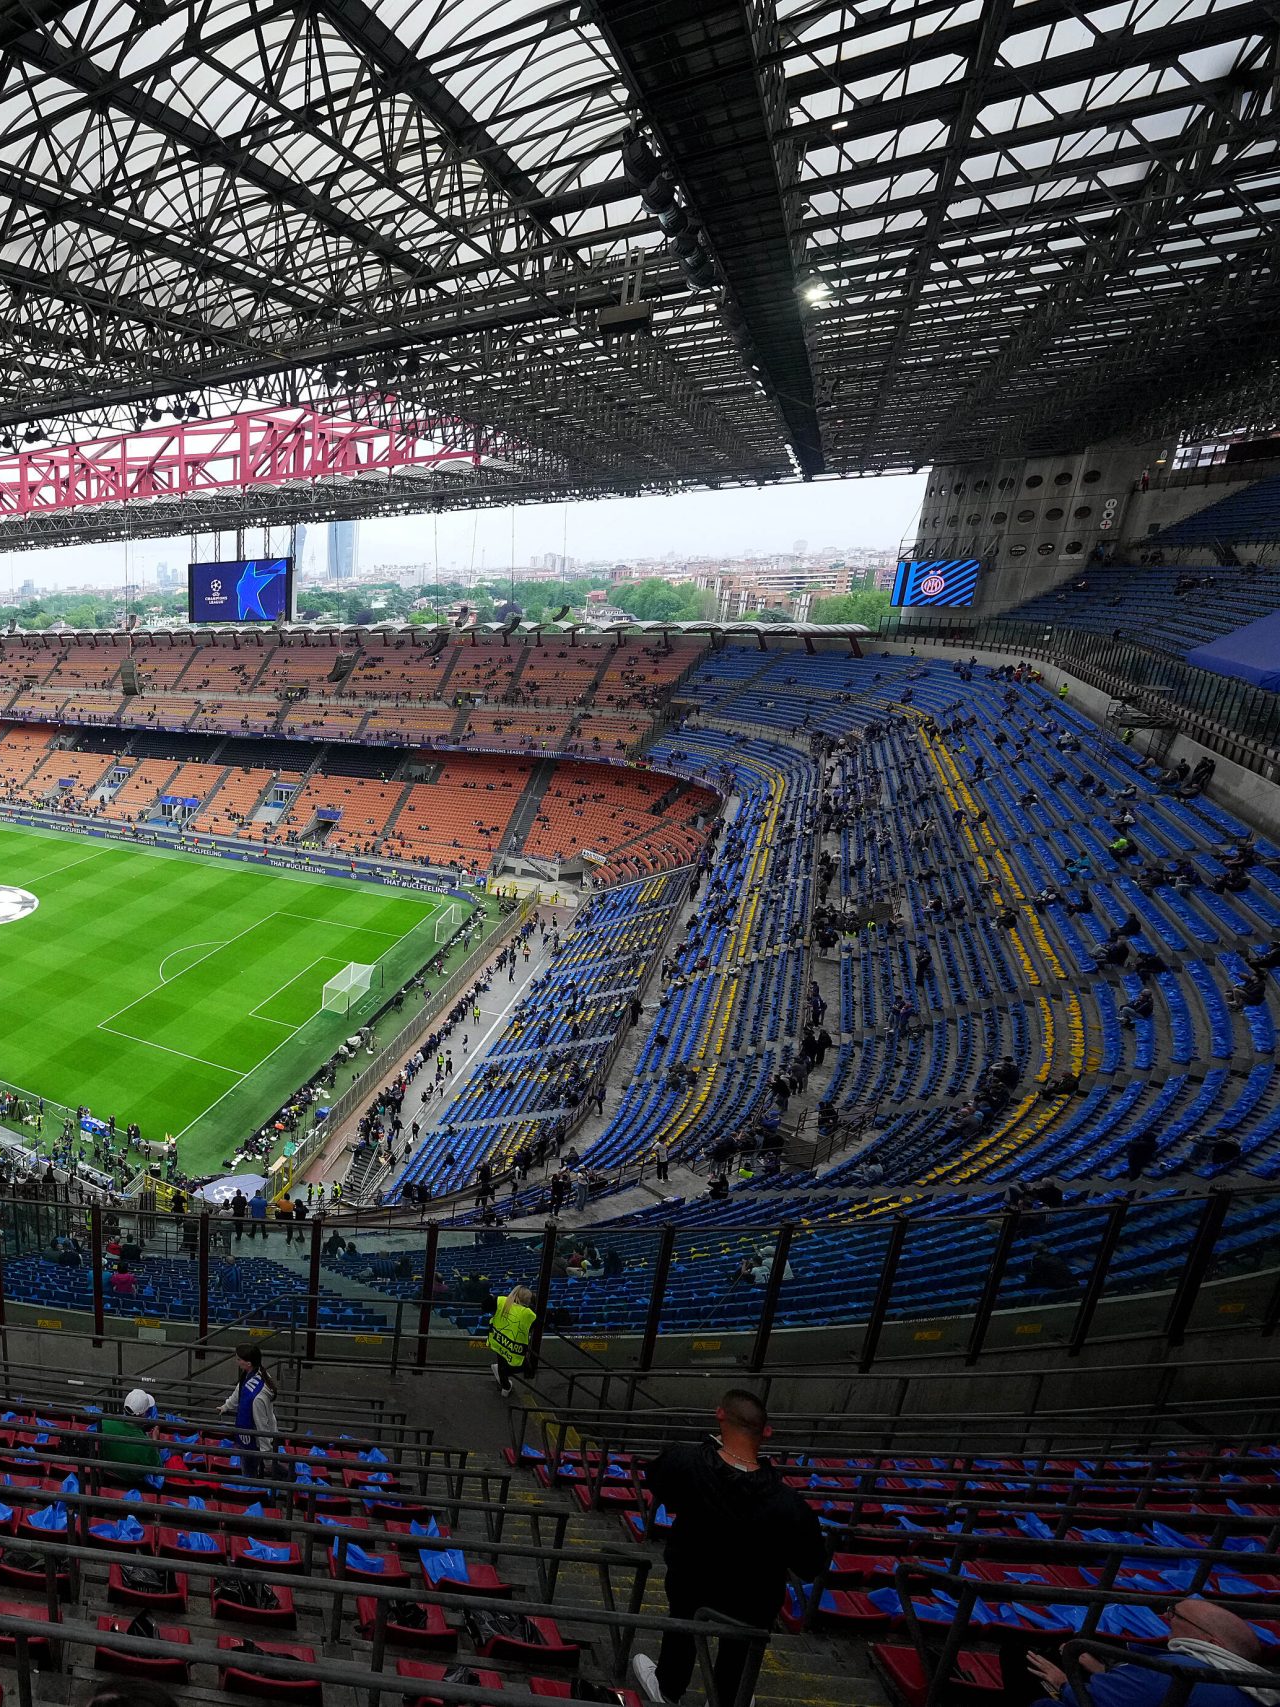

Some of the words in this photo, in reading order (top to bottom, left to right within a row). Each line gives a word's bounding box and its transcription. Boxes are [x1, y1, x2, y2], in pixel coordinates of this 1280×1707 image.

[188, 847, 222, 857] #UCLFEELING
[286, 863, 325, 874] #UCLFEELING
[402, 881, 448, 894] #UCLFEELING
